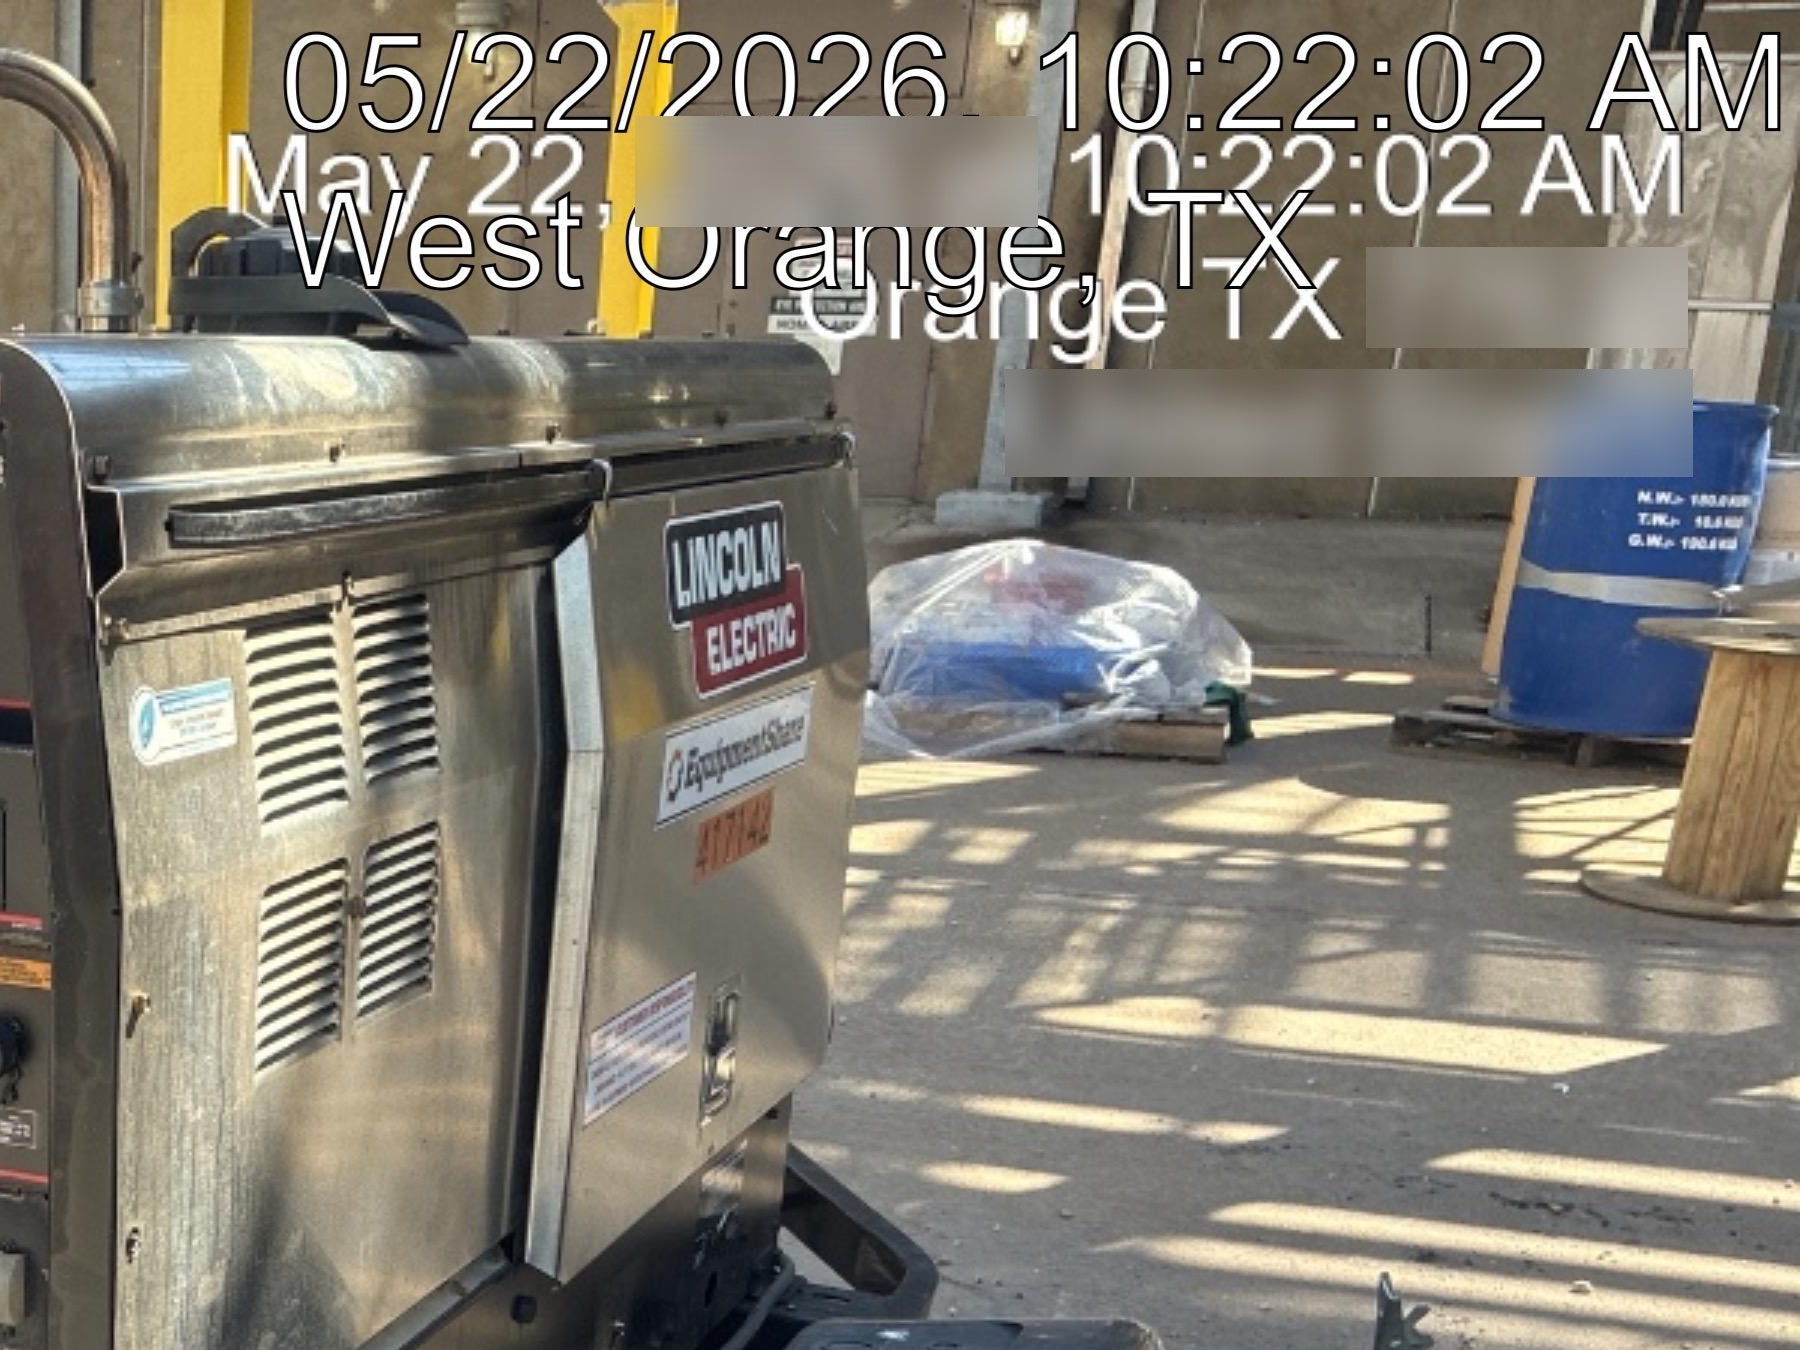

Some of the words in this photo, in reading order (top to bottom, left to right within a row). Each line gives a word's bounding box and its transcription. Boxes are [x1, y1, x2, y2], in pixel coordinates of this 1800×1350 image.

[673, 520, 782, 611] LINCOLN
[706, 602, 797, 676] ELECTRIC
[683, 714, 805, 793] EquipmentShare
